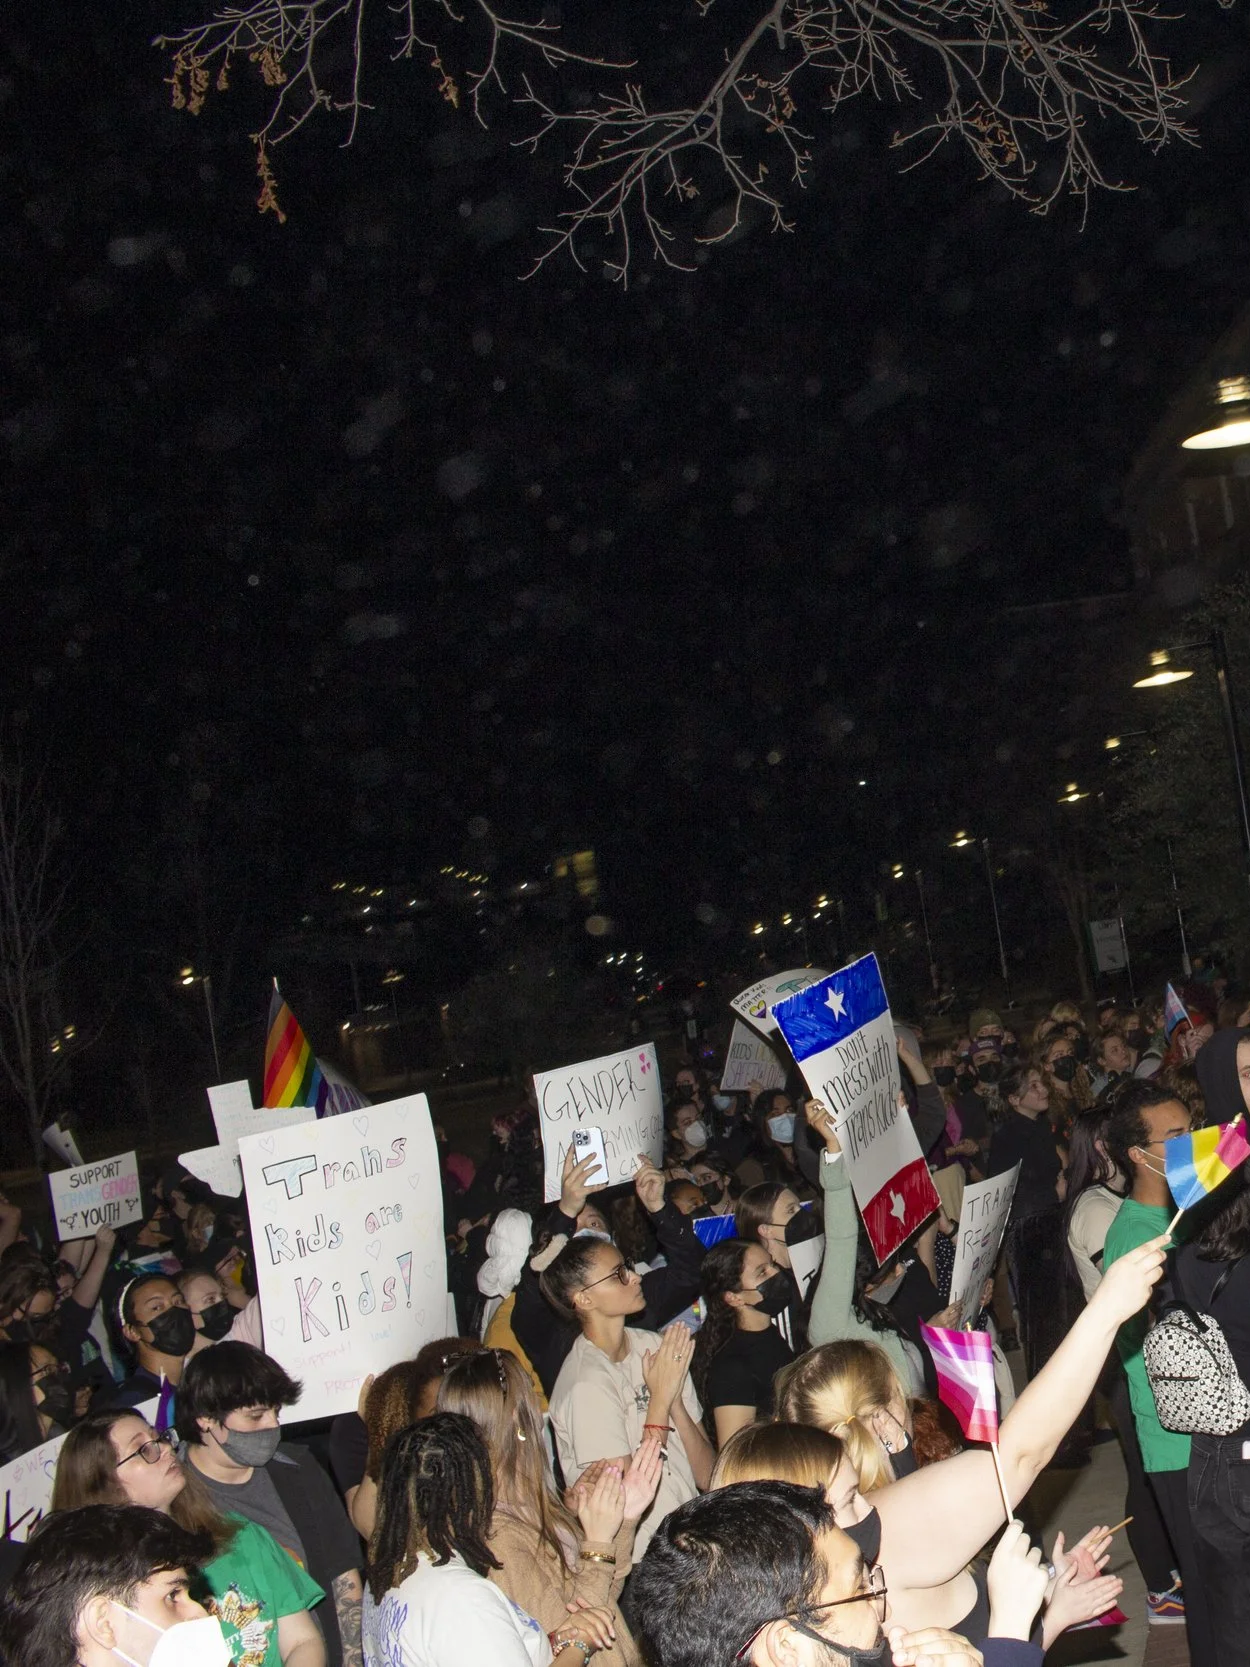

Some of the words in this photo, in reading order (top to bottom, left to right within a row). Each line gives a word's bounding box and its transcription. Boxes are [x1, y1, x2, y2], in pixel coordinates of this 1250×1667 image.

[835, 1030, 868, 1071] Don't
[543, 1059, 647, 1122] GENDER
[262, 1137, 407, 1200] Trans
[556, 1116, 649, 1177] ARMING
[69, 1160, 122, 1189] SUPPORT
[81, 1202, 121, 1229] YOUTH
[364, 1203, 404, 1234] are
[294, 1251, 413, 1343] Kids!
